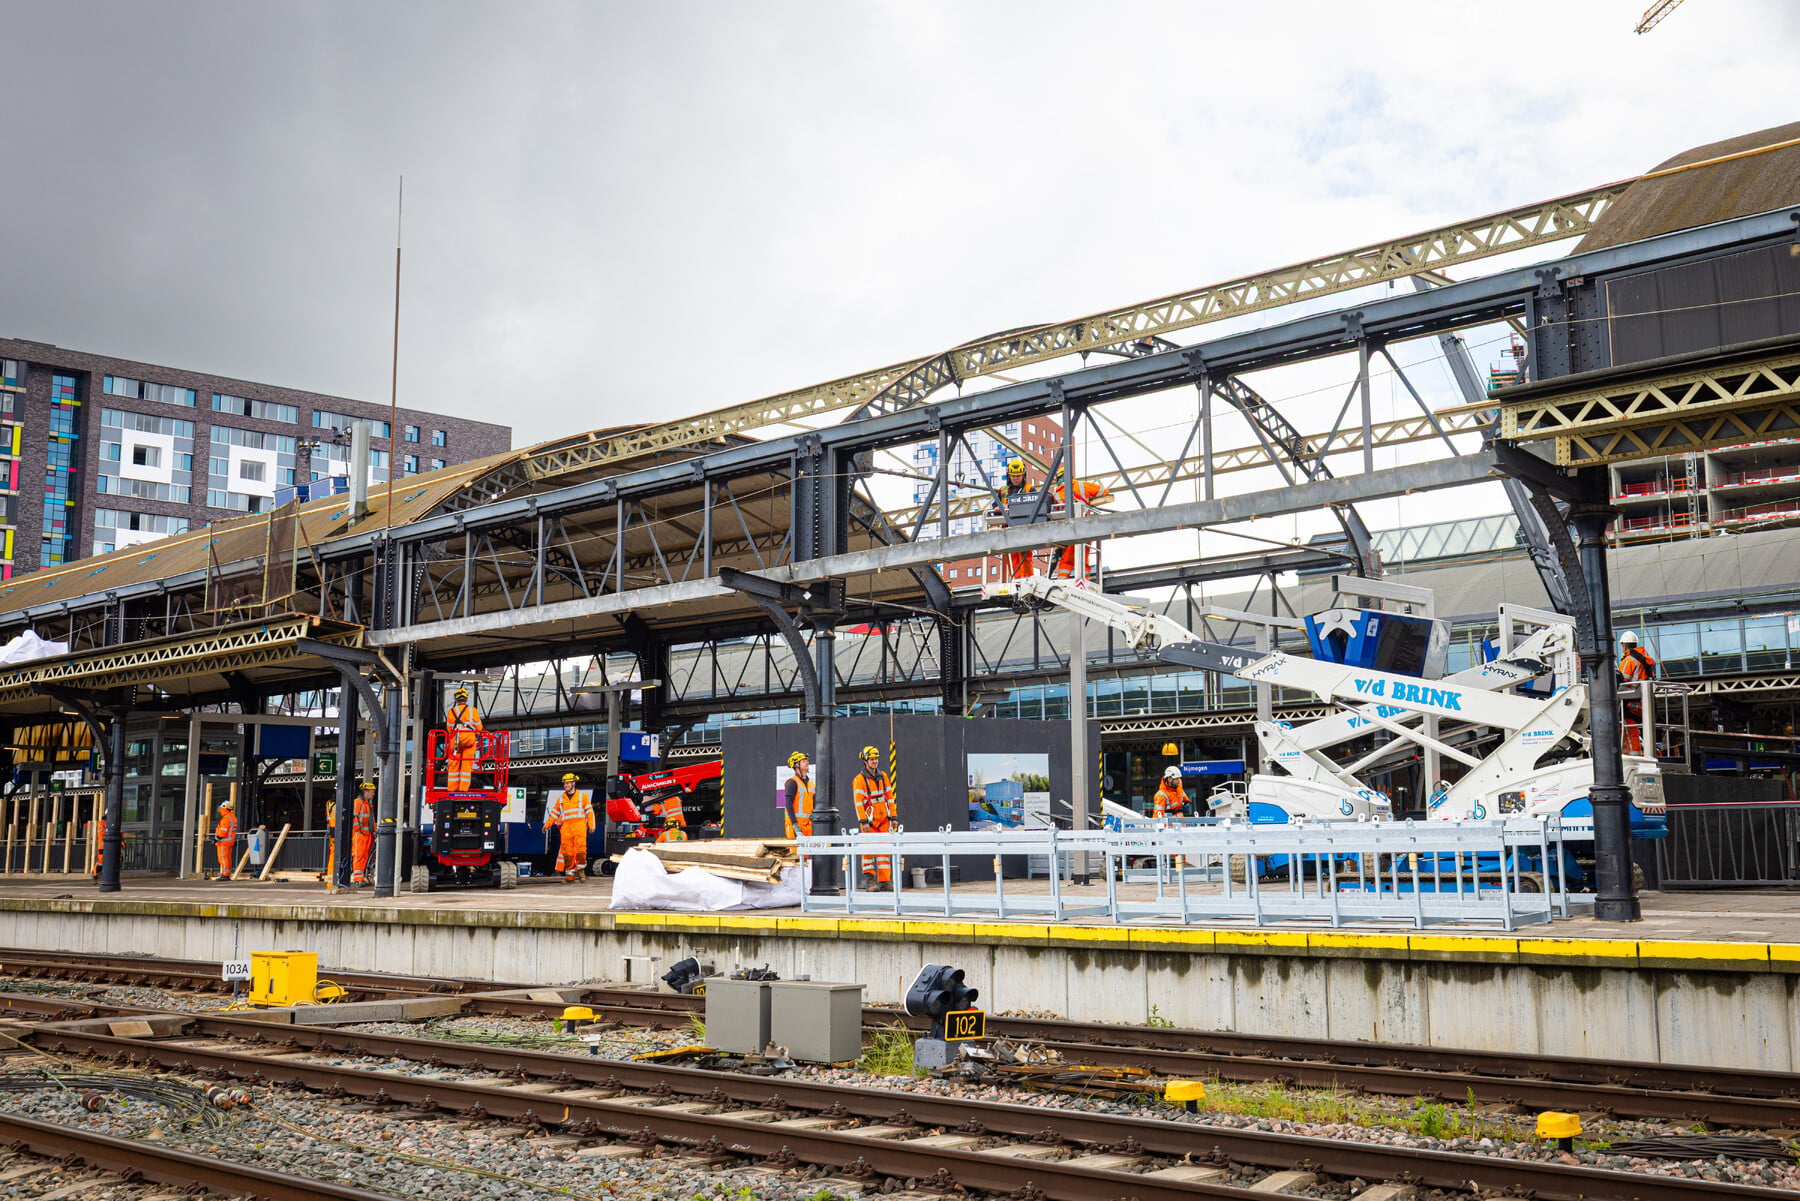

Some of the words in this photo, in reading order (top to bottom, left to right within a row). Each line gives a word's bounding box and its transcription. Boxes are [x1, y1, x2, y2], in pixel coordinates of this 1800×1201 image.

[1252, 657, 1287, 678] HYRAX
[1484, 665, 1518, 679] HYRAX
[1354, 679, 1385, 696] v/d
[1391, 682, 1462, 711] BRINK
[226, 964, 248, 974] 103A
[955, 1016, 976, 1035] 102
